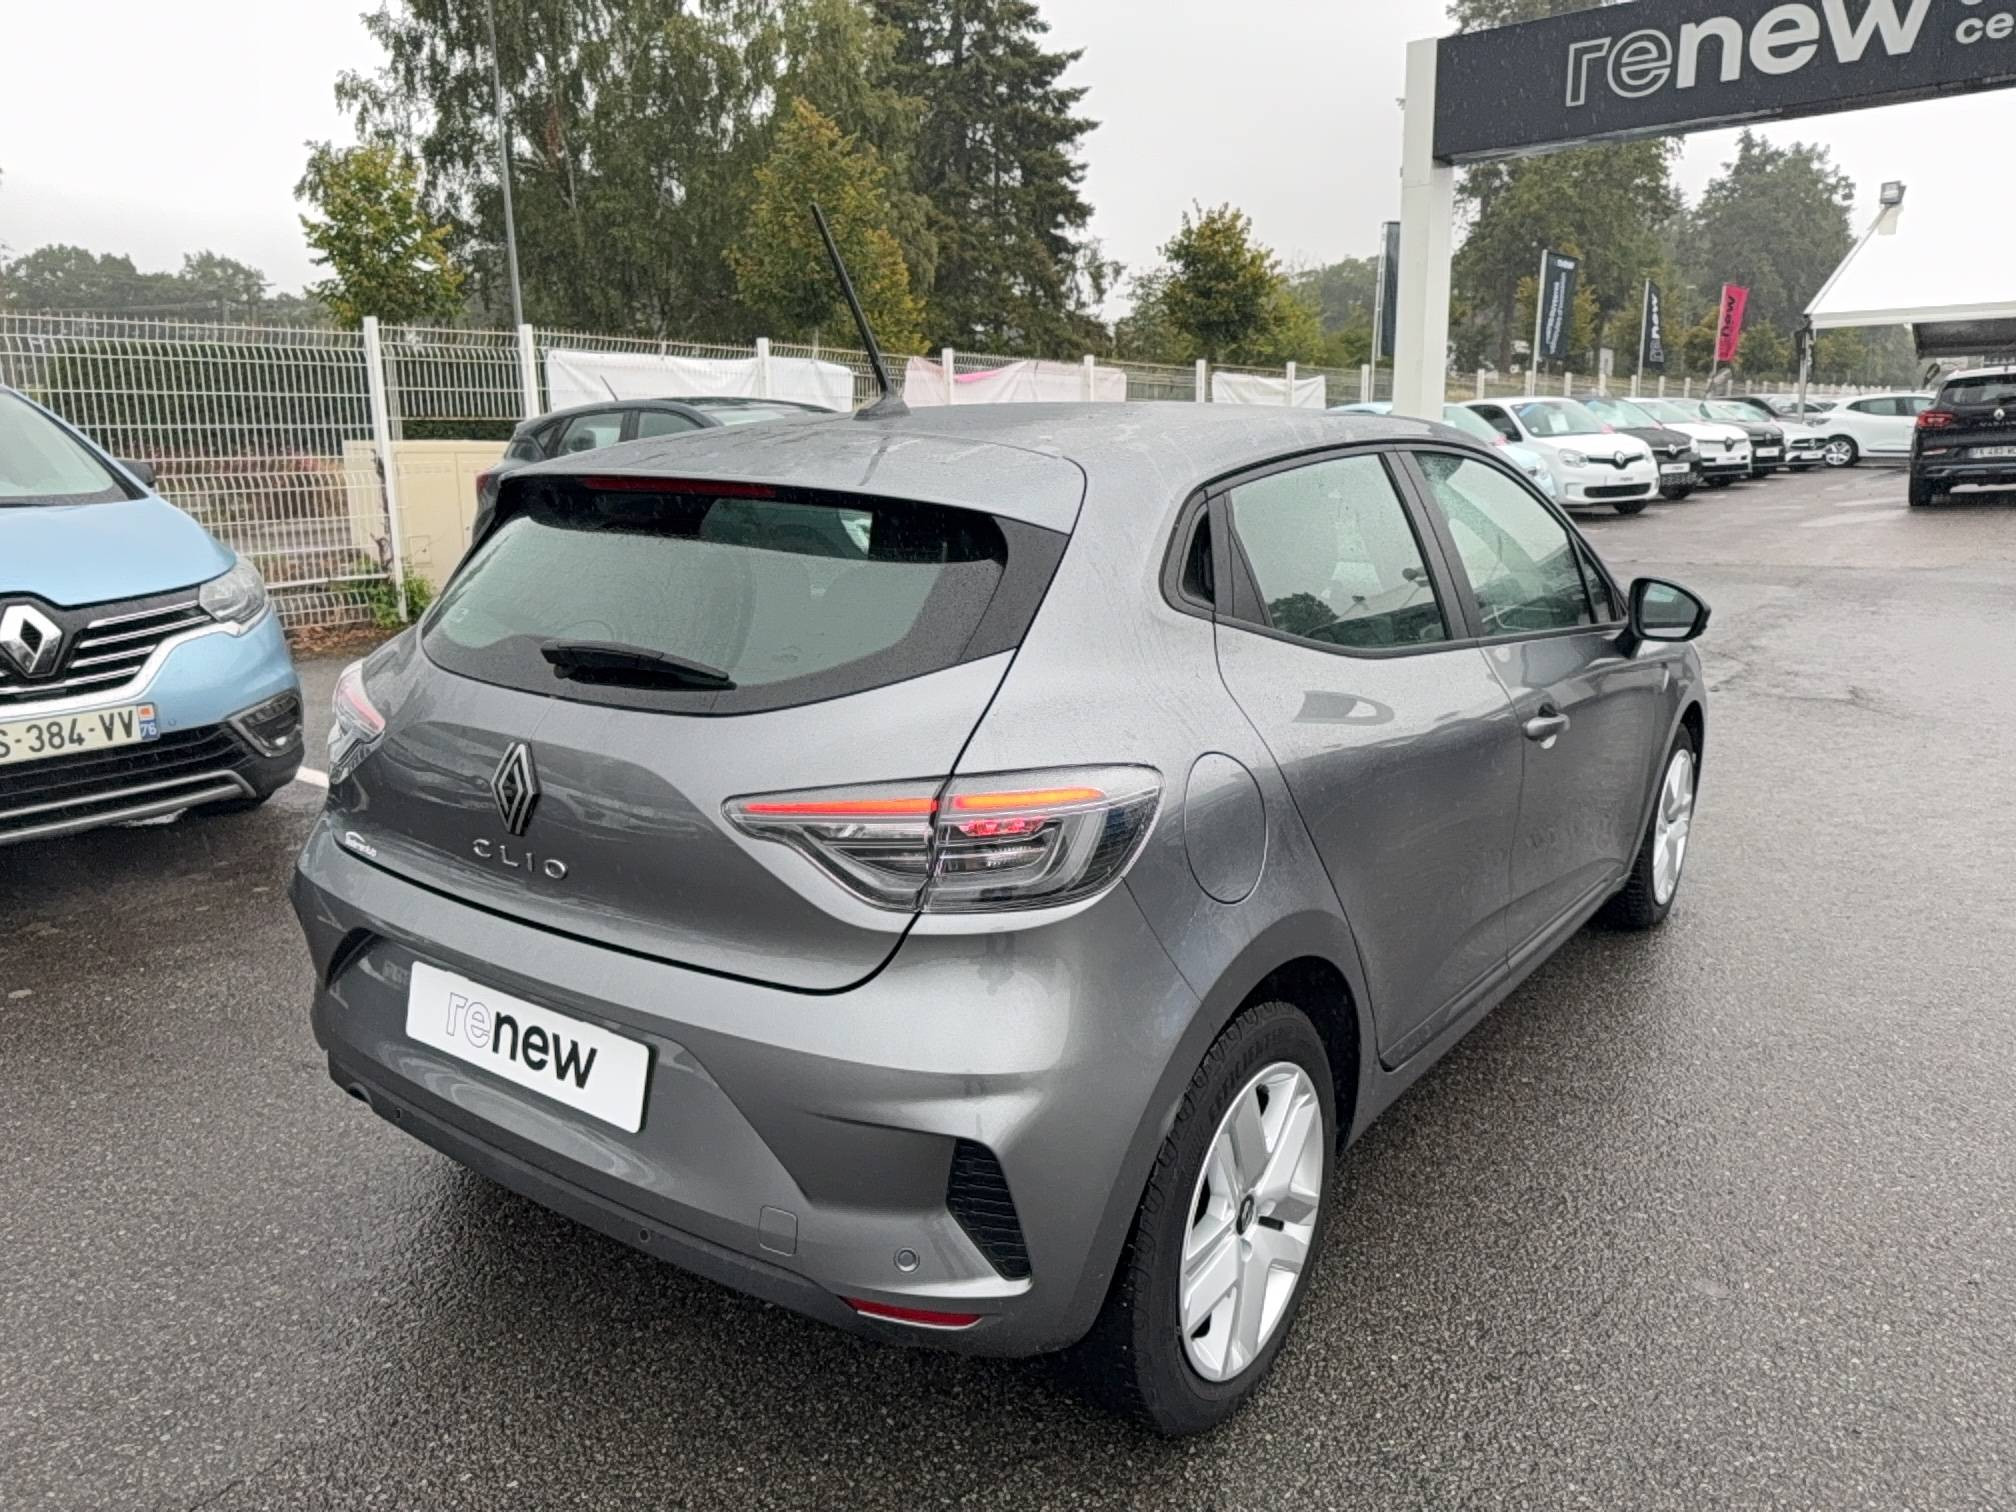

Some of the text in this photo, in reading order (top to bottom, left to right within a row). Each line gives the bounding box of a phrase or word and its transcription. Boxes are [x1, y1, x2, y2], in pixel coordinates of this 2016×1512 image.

[1565, 0, 1931, 107] renew
[140, 722, 157, 737] 76
[472, 838, 569, 880] CLIO
[446, 991, 598, 1089] renew
